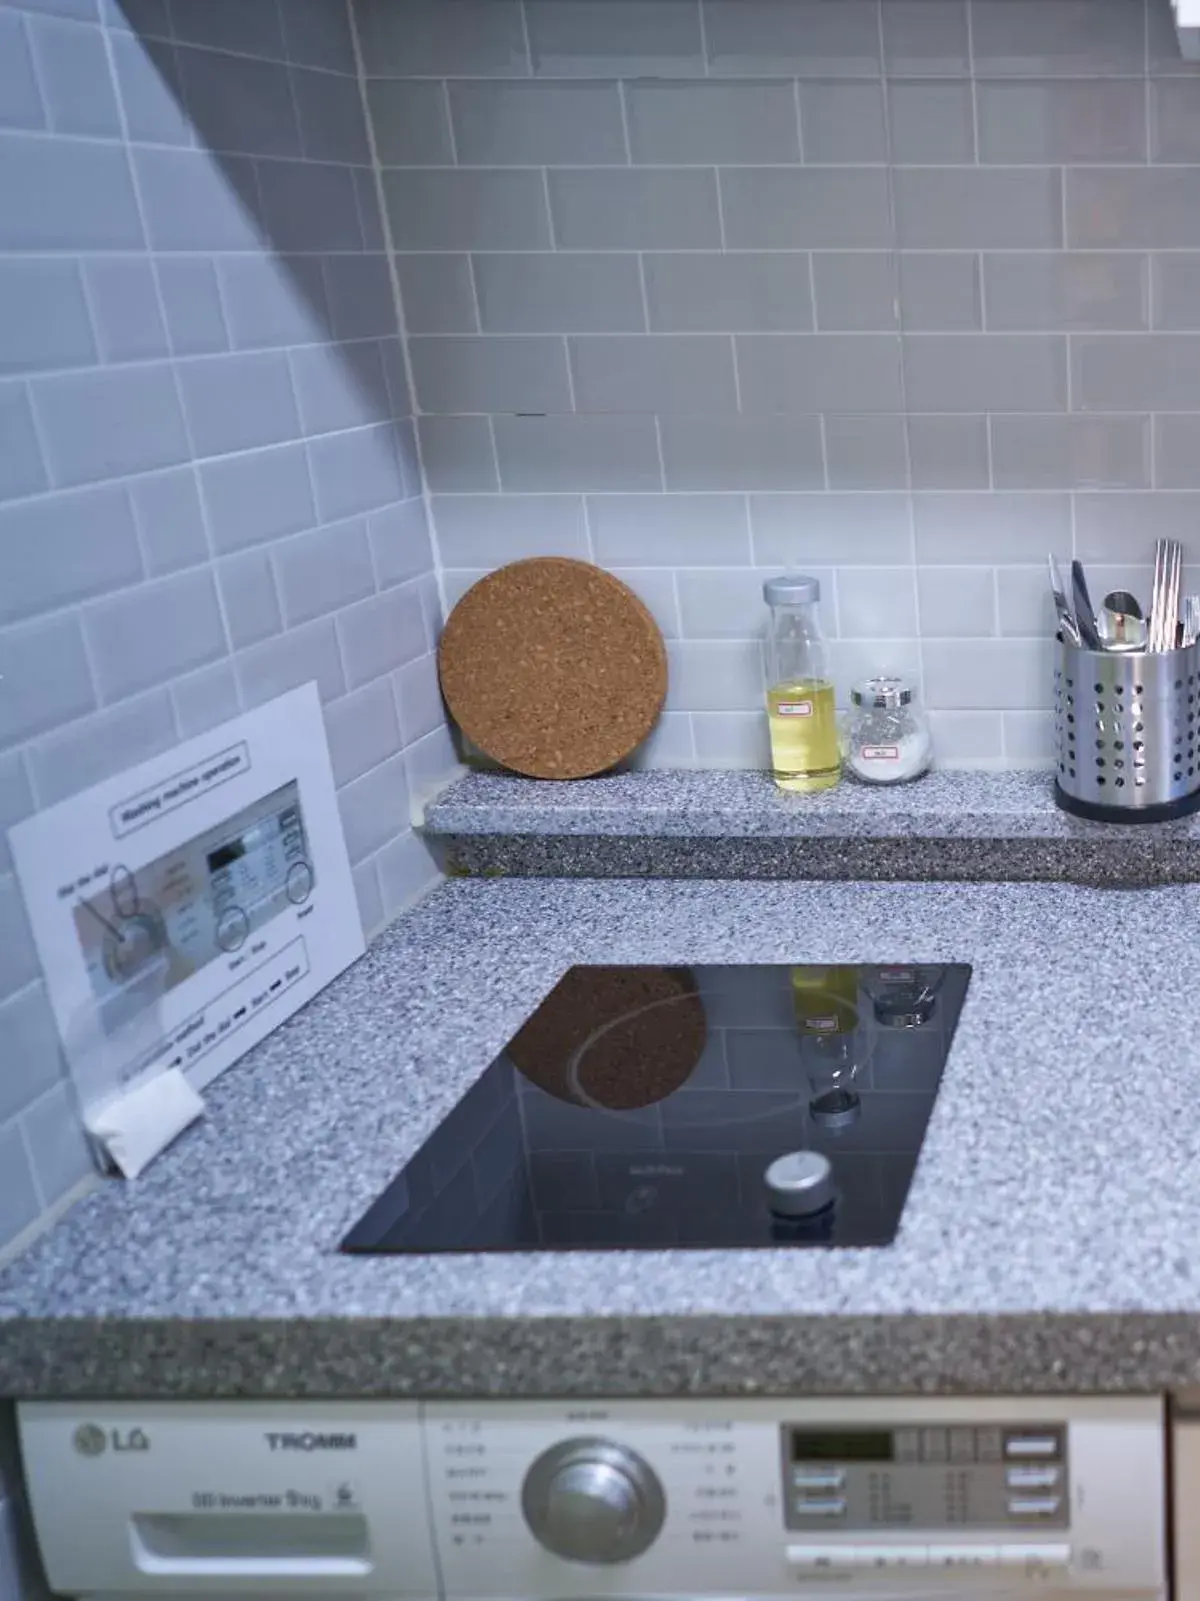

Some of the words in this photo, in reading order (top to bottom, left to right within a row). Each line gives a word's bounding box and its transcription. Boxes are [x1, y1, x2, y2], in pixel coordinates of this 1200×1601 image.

[162, 777, 200, 800] machine
[201, 755, 241, 782] operation
[111, 1427, 150, 1453] LG
[264, 1431, 358, 1452] TROMM
